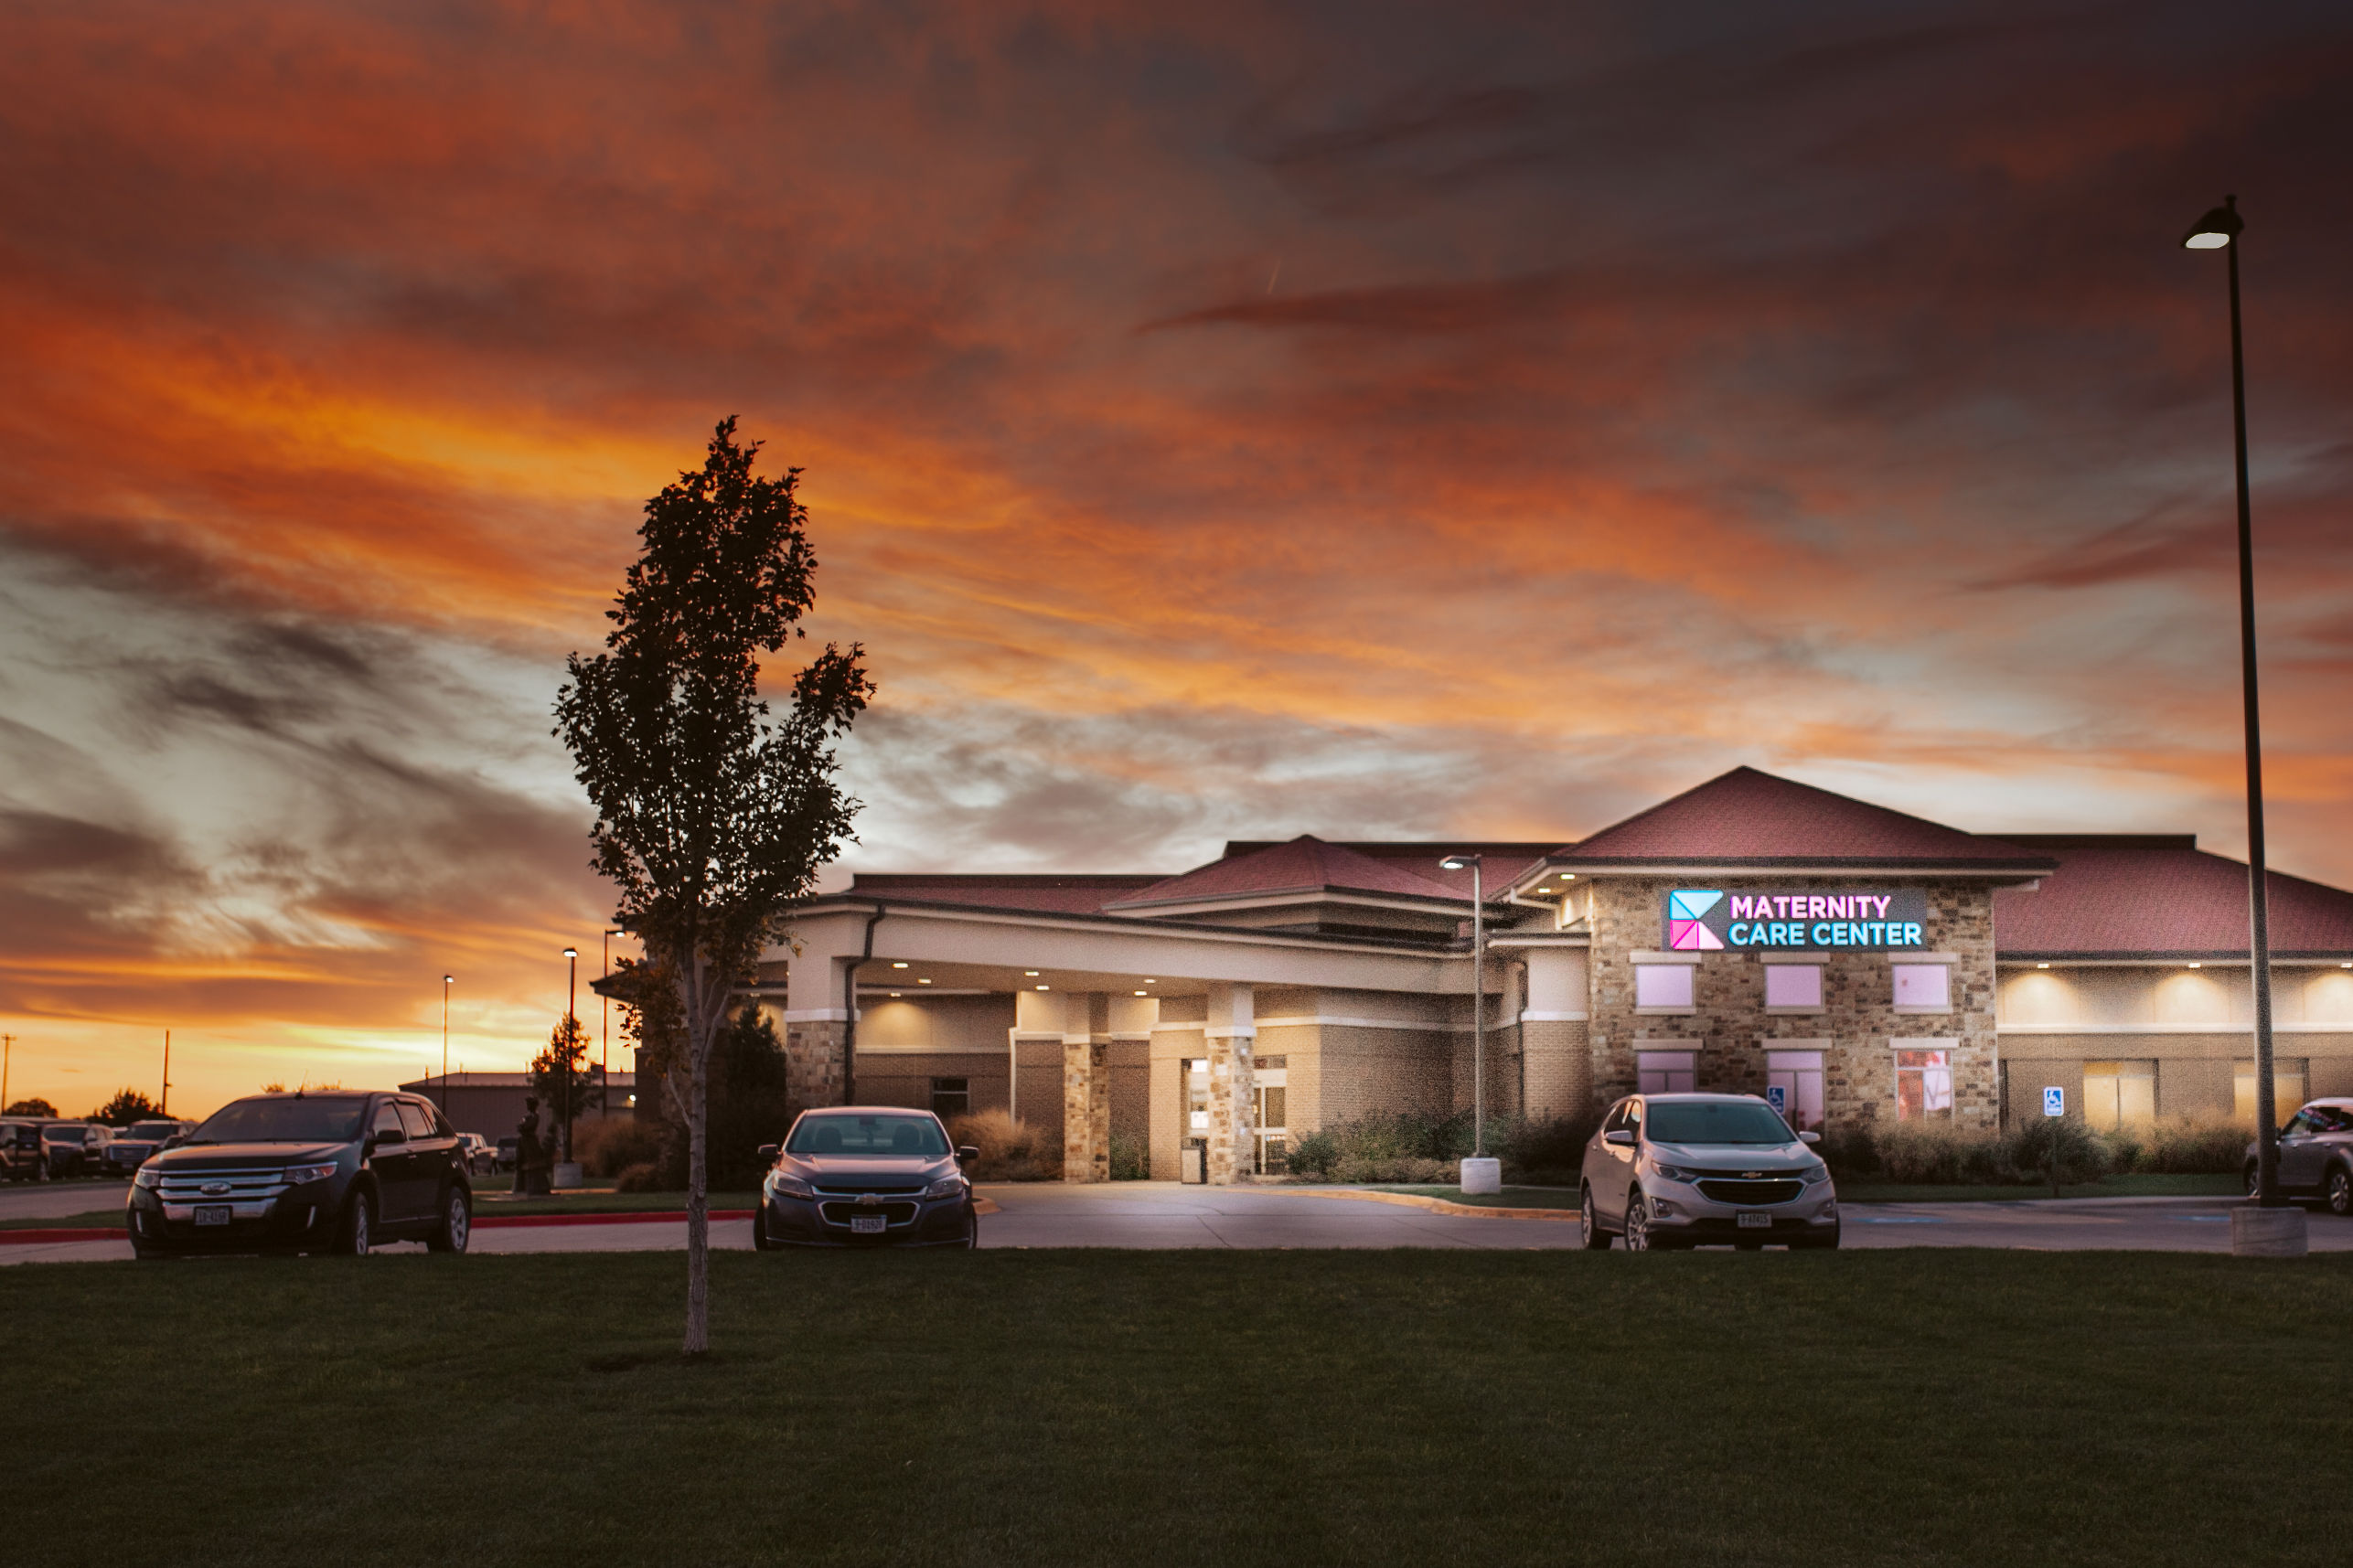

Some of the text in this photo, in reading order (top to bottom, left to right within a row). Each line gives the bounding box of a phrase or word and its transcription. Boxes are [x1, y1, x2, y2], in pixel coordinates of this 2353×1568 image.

[1730, 895, 1890, 918] MATERNITY
[1728, 922, 1921, 945] CARE CENTER
